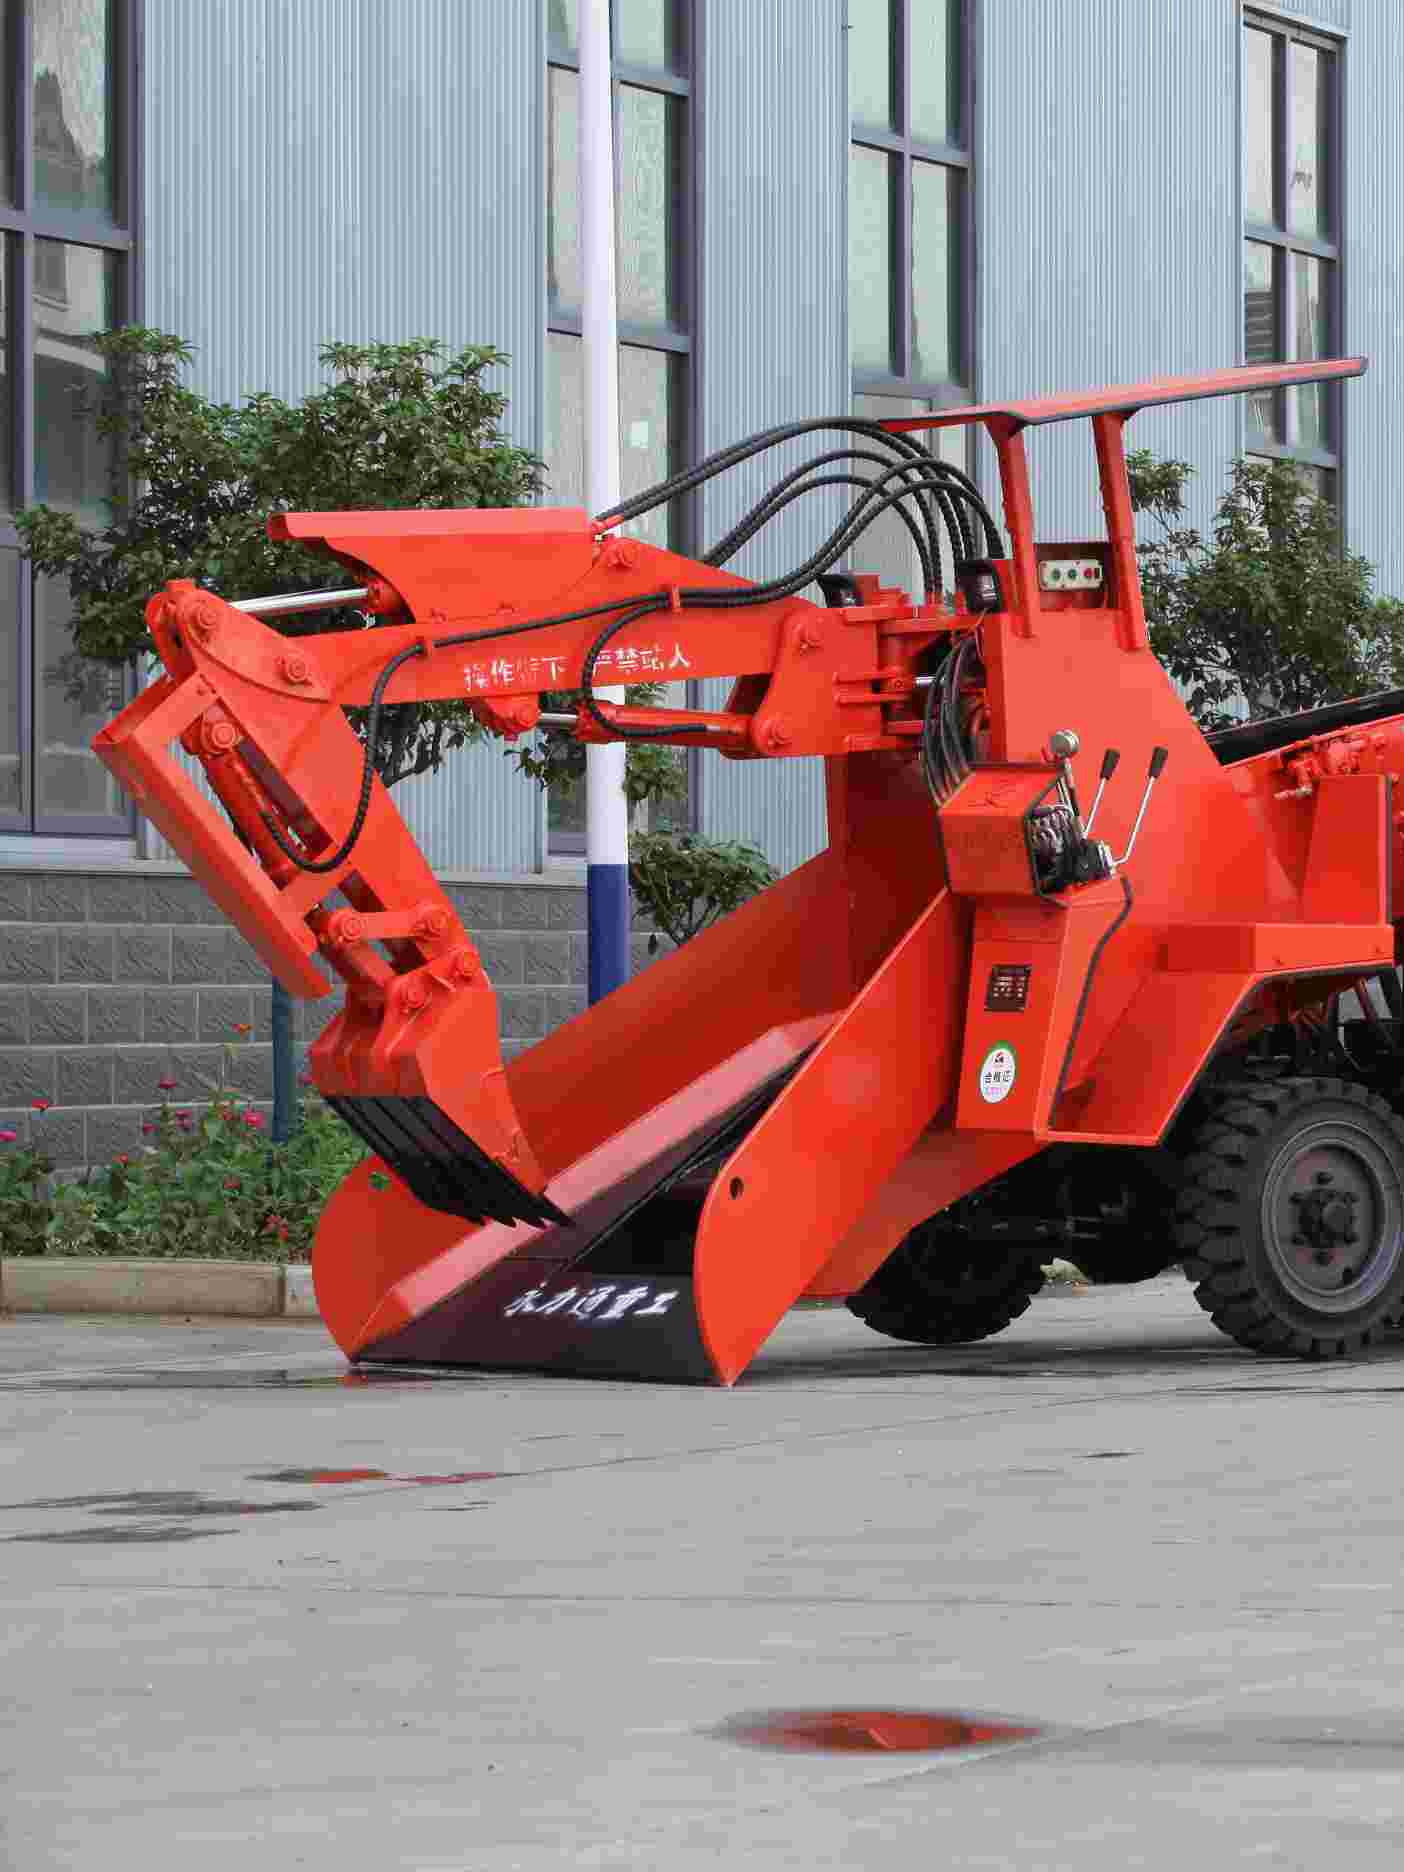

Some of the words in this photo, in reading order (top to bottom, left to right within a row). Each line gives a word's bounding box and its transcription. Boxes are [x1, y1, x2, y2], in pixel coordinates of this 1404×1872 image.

[592, 643, 691, 677] 严禁站人
[503, 1281, 680, 1320] 永力通重工
